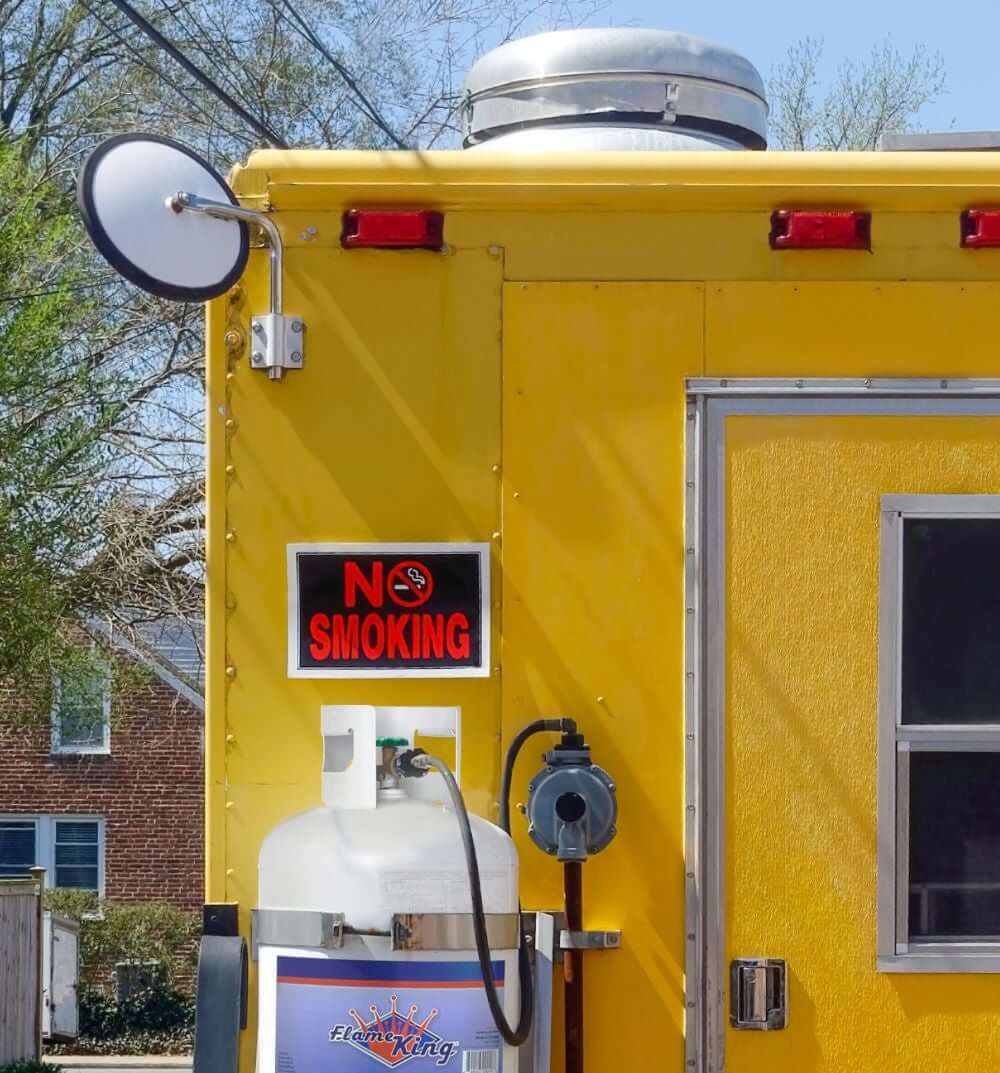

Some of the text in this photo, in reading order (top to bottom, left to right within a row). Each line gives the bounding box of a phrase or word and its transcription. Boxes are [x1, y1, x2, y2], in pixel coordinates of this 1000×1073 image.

[309, 612, 470, 661] SMOKING
[329, 1025, 393, 1042] Flame
[391, 1034, 456, 1065] King
